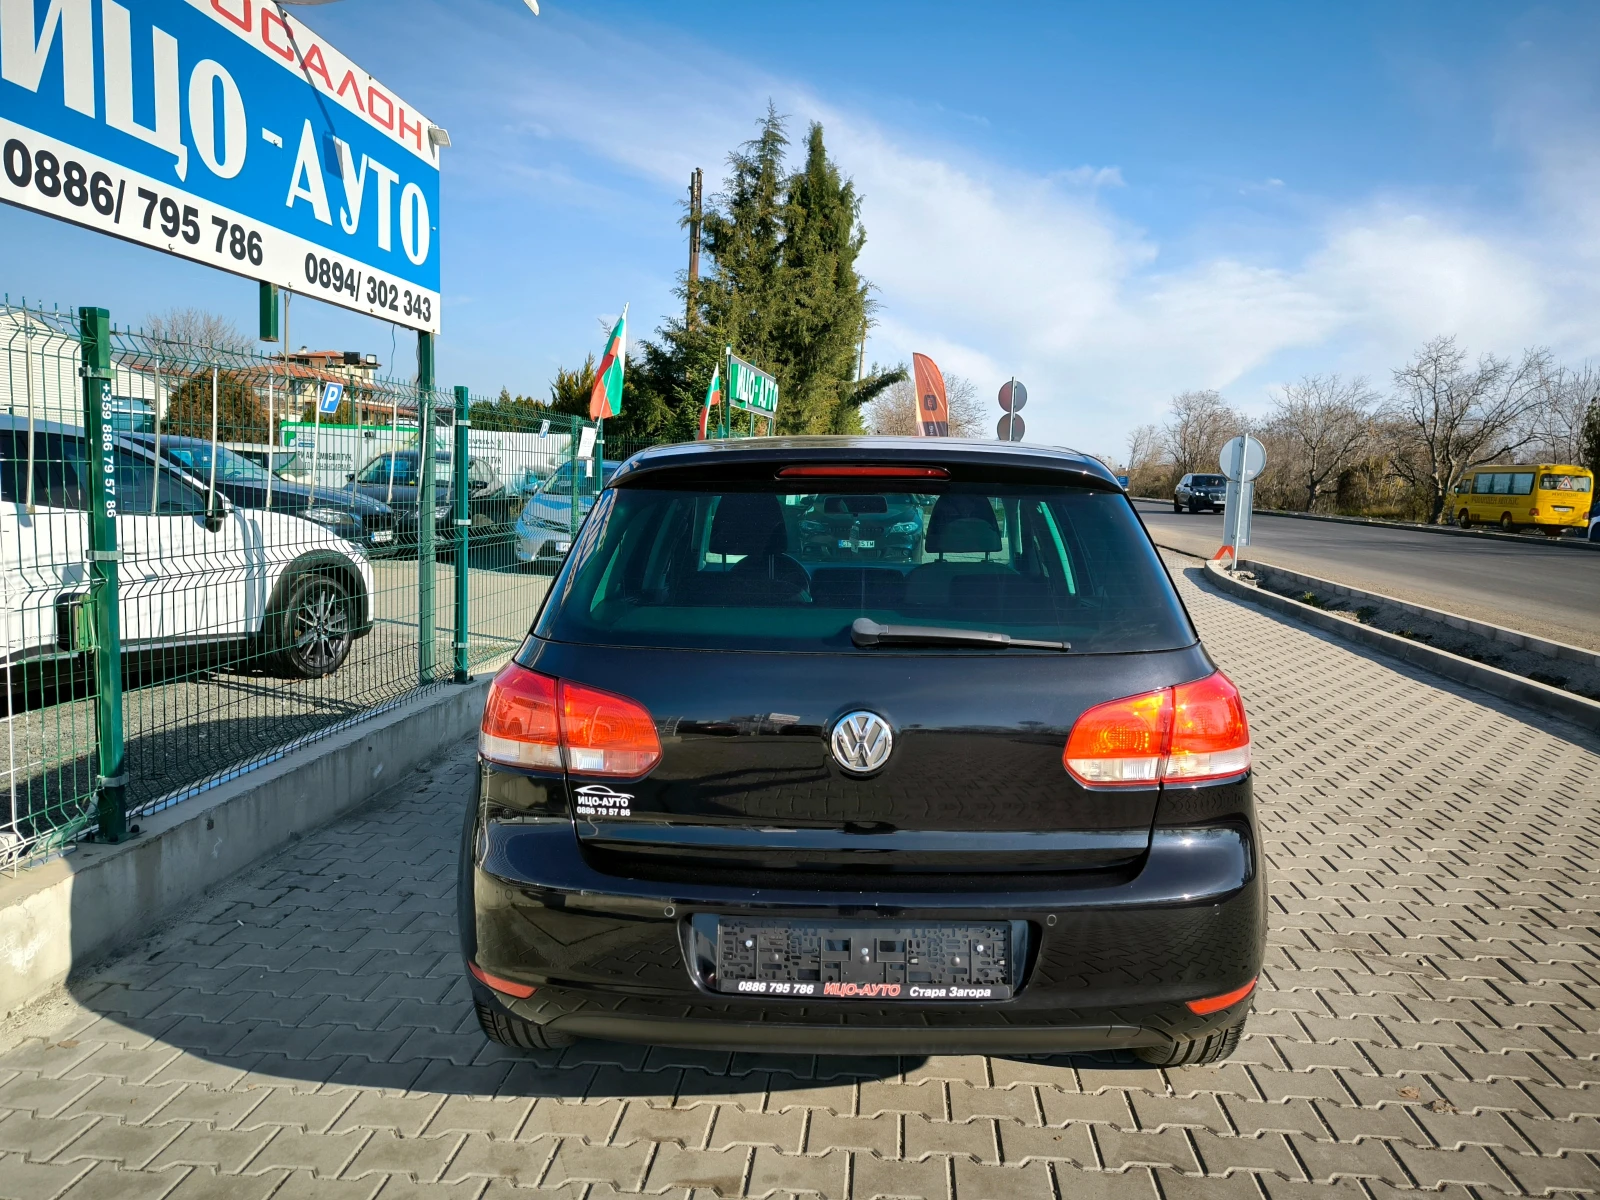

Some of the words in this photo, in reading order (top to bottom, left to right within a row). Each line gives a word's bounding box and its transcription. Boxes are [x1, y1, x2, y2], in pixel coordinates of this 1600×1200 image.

[3, 138, 127, 224] 0886/
[137, 186, 201, 245] 795
[211, 215, 264, 266] 786
[304, 252, 362, 302] 0894/
[366, 279, 399, 312] 302
[403, 289, 432, 323] 343
[101, 383, 112, 420] +359
[323, 386, 339, 409] P
[102, 423, 113, 451] 886
[103, 455, 114, 474] 79
[104, 478, 116, 496] 57
[106, 499, 117, 518] 86
[578, 796, 629, 807] ИЦО-АУТО
[597, 807, 606, 815] 79
[608, 808, 619, 816] 57
[738, 981, 767, 992] 0886
[769, 983, 791, 993] 795
[793, 984, 815, 994] 786
[823, 981, 901, 998] ИЦО-АУТО
[909, 986, 946, 999] Стара
[948, 986, 992, 999] Загора
